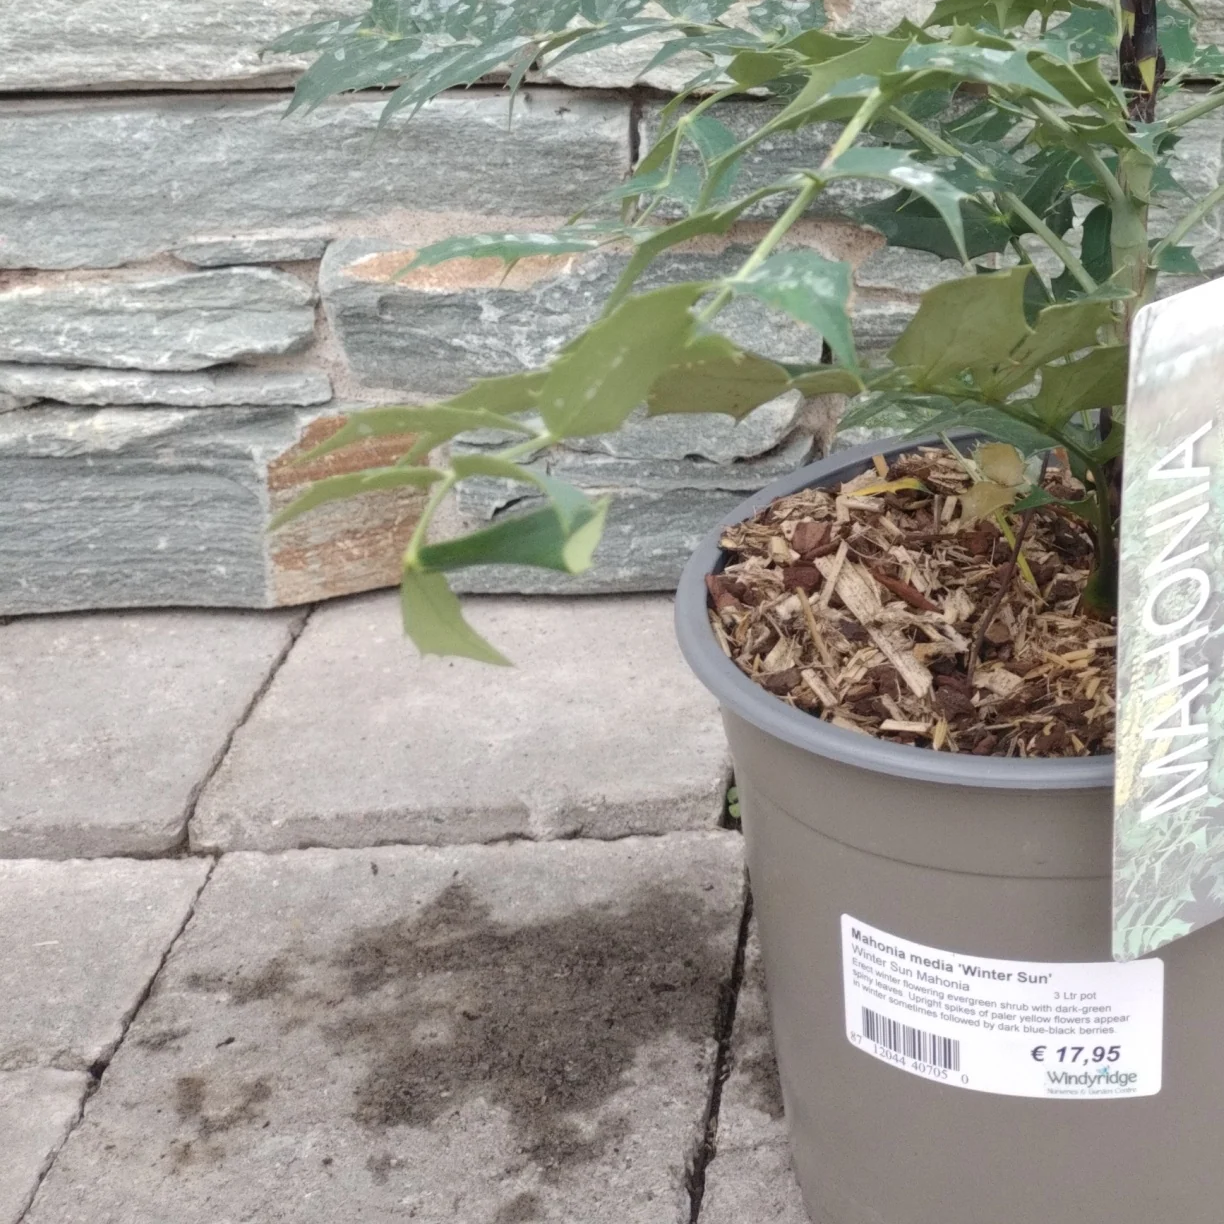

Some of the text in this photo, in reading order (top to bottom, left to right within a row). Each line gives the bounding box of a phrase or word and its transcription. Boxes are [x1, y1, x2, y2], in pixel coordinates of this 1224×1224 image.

[1139, 419, 1213, 824] MAHONIA
[851, 927, 906, 959] Mahonia
[910, 953, 953, 973] media
[851, 942, 970, 992] Winter Sun Mahonia
[852, 957, 1112, 1014] Erect winter flowering evergreen shrub with dark-green
[852, 969, 873, 985] spiny
[908, 991, 941, 1008] Upright
[944, 1003, 976, 1016] spikes
[979, 1009, 989, 1018] of
[991, 1011, 1017, 1021] paler
[1019, 1014, 1051, 1024] yellow
[1054, 1015, 1091, 1024] flowers
[1094, 1015, 1130, 1025] appear
[862, 984, 886, 1000] winter
[888, 996, 938, 1018] sometimes
[940, 1011, 980, 1027] followed
[983, 1020, 995, 1031] by
[998, 1022, 1020, 1032] dark
[1023, 1025, 1076, 1035] blue-black
[1054, 991, 1097, 1001] 3 Ltr pot
[850, 1030, 969, 1085] 87 12044 40705 0
[1031, 1045, 1121, 1066] € 17,95
[1047, 1070, 1138, 1088] Windyridge
